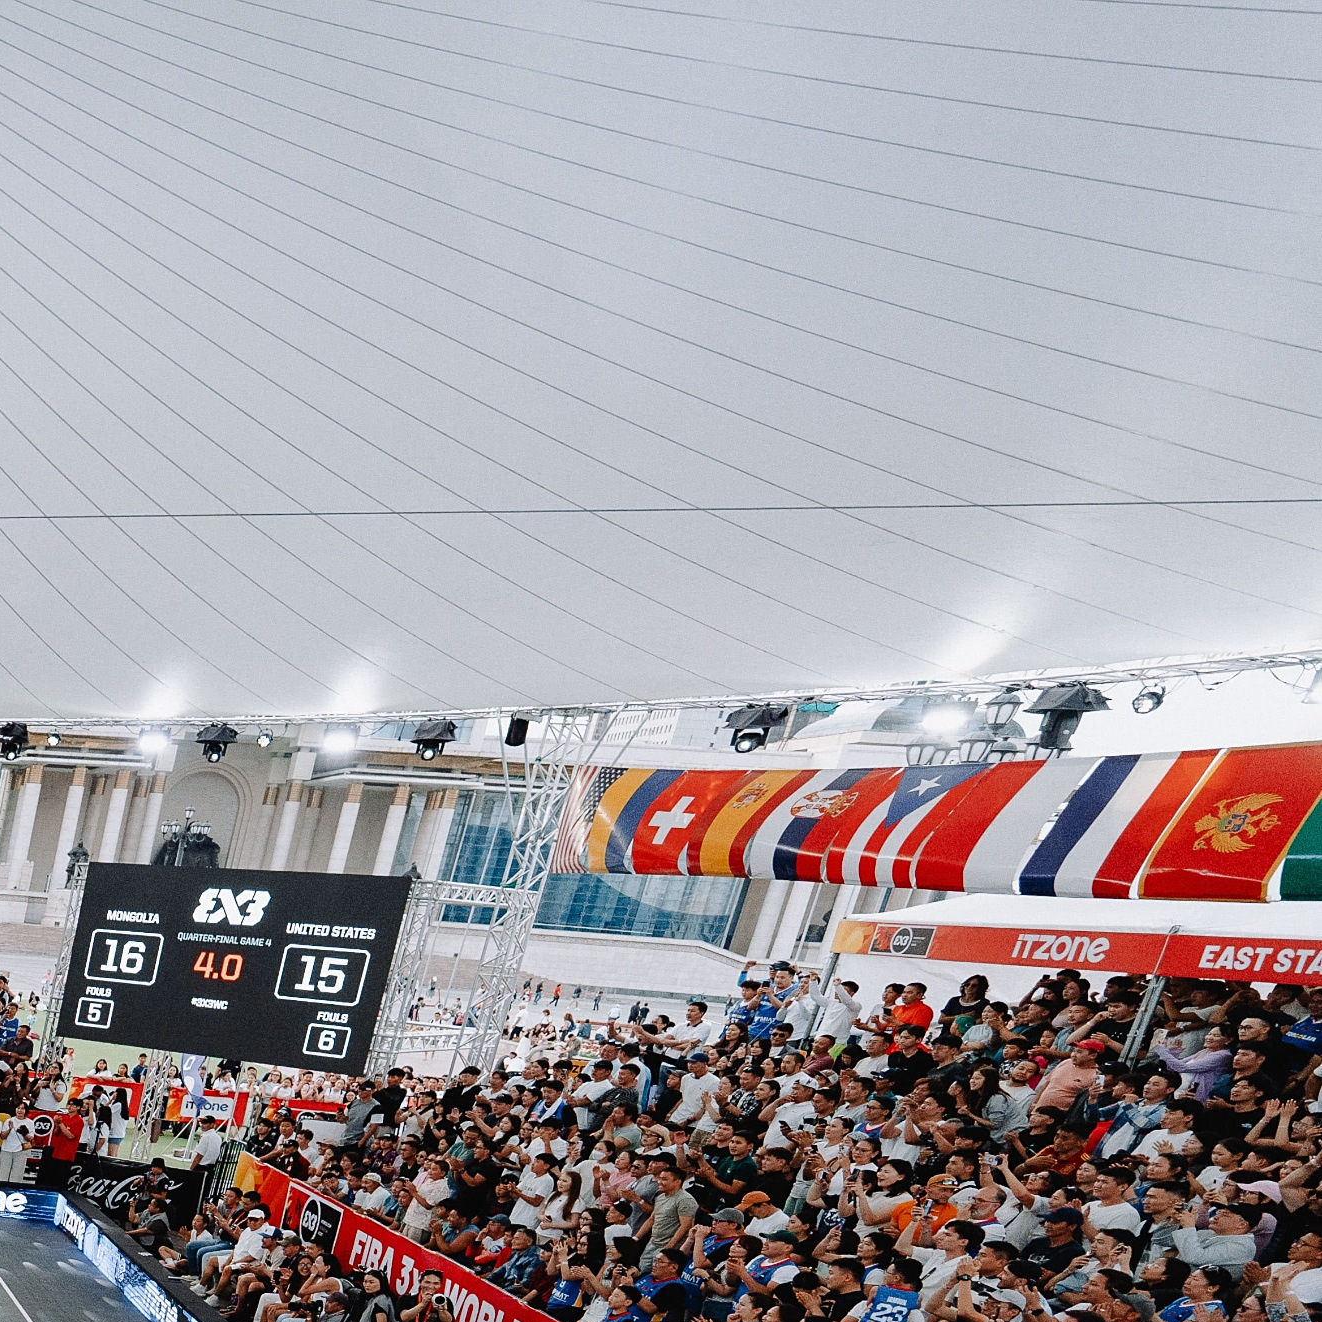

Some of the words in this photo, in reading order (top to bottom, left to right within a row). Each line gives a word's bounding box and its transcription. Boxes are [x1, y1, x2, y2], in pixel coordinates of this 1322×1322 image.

[106, 909, 160, 925] MONGOLIA
[177, 931, 239, 946] QUARTER-FINAL
[240, 936, 264, 947] GAME
[265, 937, 272, 948] 4
[286, 922, 330, 937] UNITED
[331, 926, 377, 941] STATES
[100, 938, 146, 975] 16
[1198, 944, 1274, 971] EAST
[193, 951, 244, 982] 4.0
[294, 955, 349, 994] 15
[85, 985, 112, 998] FOULS
[87, 1004, 103, 1023] 5
[316, 1010, 349, 1024] FOULS
[318, 1030, 336, 1050] 6
[349, 1228, 395, 1281] FIBA
